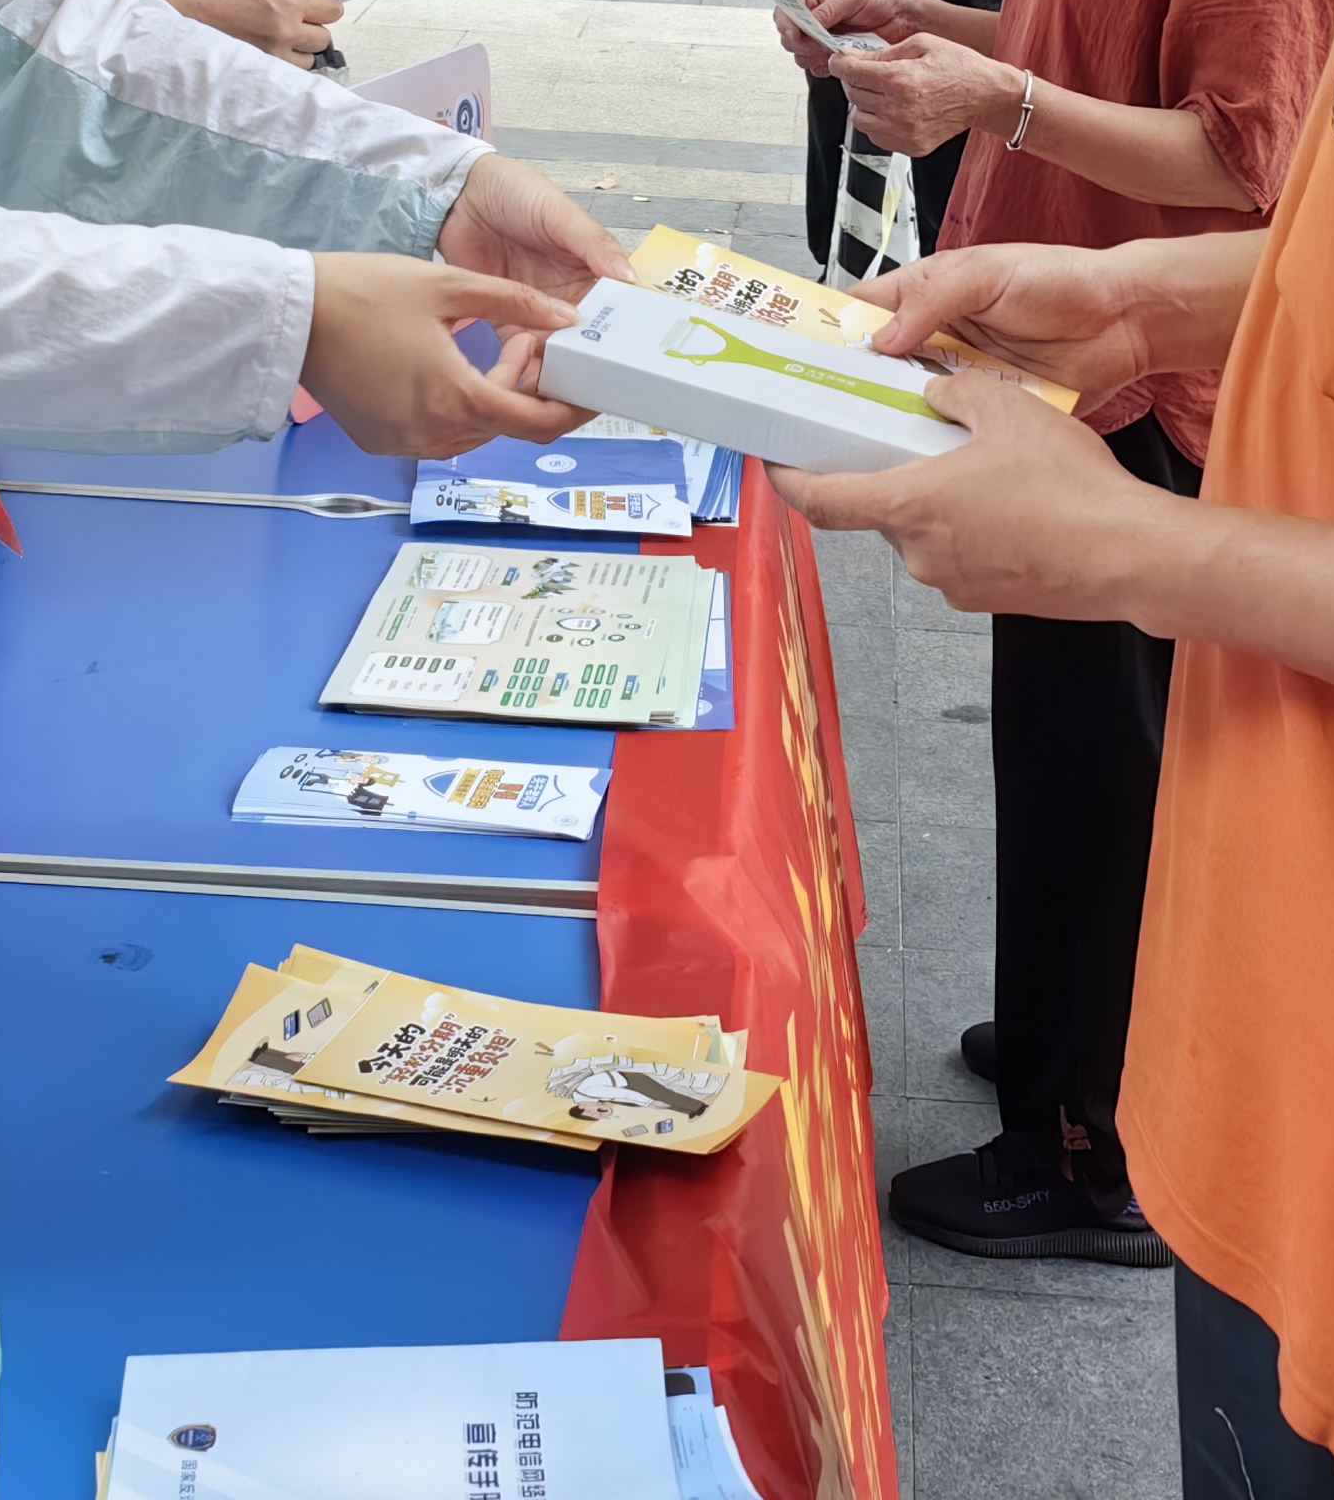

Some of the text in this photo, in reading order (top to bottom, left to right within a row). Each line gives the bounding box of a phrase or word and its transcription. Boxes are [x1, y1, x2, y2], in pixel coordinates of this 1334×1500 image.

[358, 1023, 426, 1074] 今天的
[408, 1025, 489, 1087] 可能是明天的
[179, 1459, 198, 1500] 国家反
